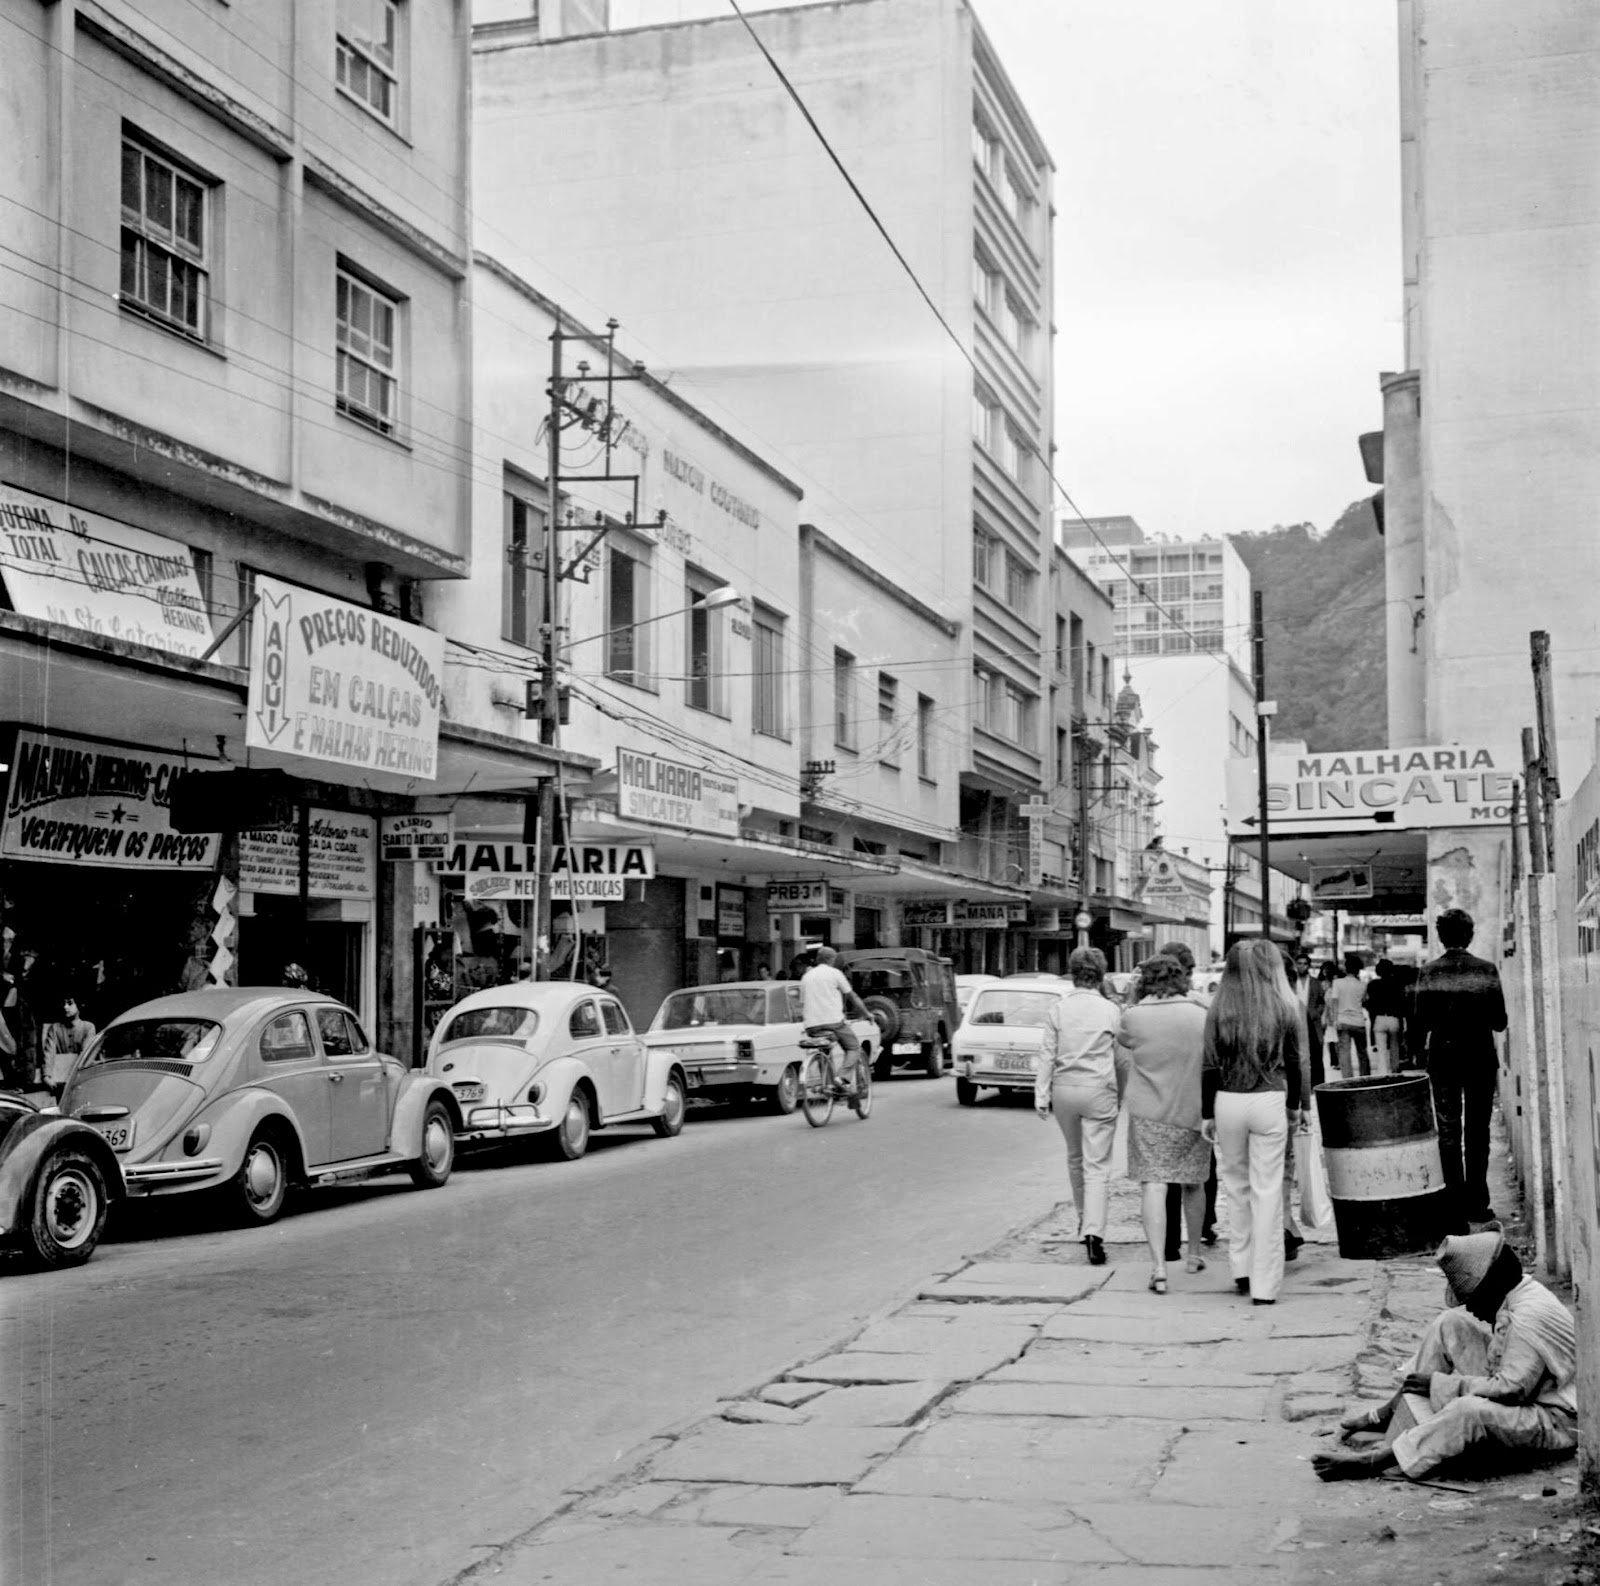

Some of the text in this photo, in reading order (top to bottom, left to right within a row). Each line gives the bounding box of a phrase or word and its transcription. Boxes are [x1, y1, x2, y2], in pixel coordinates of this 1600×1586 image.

[6, 534, 62, 562] TOTAL
[161, 607, 205, 635] HERING
[265, 621, 282, 733] AQUI
[300, 608, 440, 709] PREÇOS REDUZIDOS
[308, 665, 422, 728] EM CALÇAS
[293, 711, 433, 774] E MALHAS HERING
[1297, 749, 1495, 778] MALHARIA
[622, 753, 701, 802] MALHARIA
[1265, 772, 1526, 811] SINCATE
[629, 791, 693, 824] SINCATEX
[21, 816, 209, 866] VERIFIQUEM OS PREÇOS
[586, 879, 622, 898] CALÇAS
